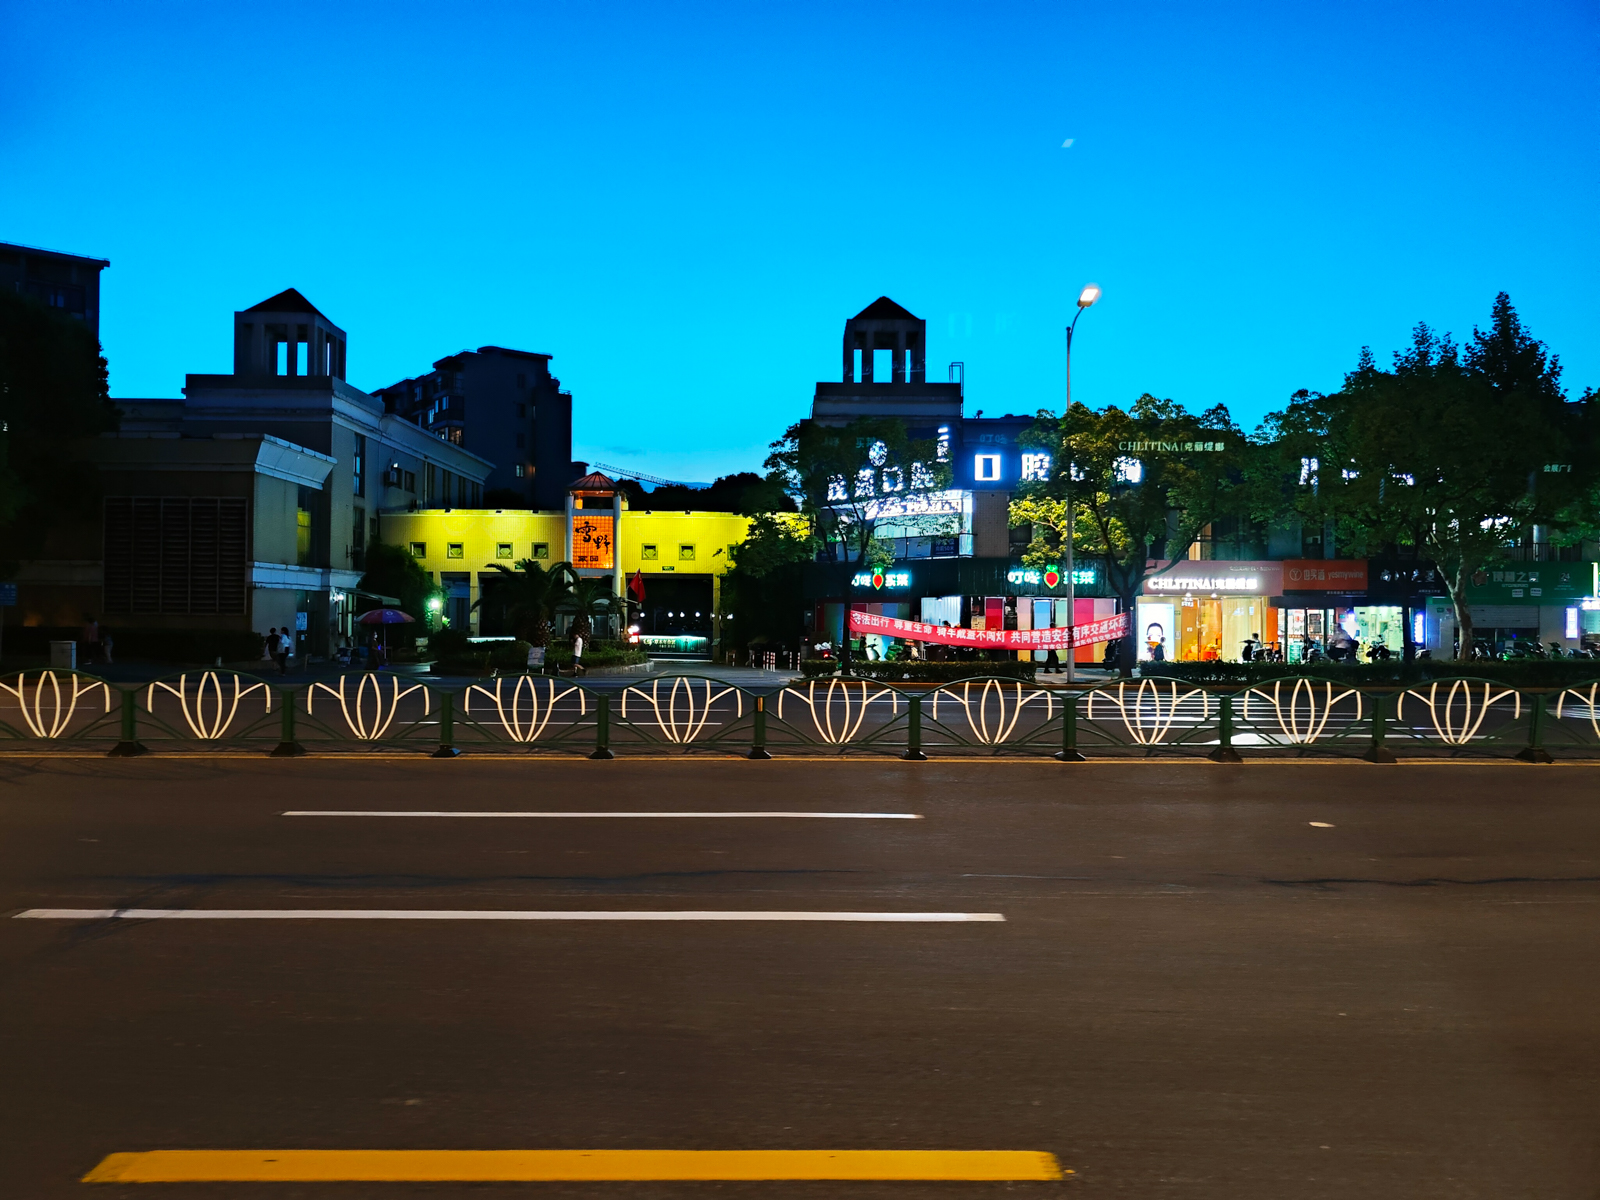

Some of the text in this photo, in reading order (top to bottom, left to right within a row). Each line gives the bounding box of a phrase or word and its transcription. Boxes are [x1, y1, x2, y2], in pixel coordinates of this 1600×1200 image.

[1118, 441, 1179, 452] CHLITINA
[1007, 571, 1041, 585] 叮咚
[851, 612, 890, 628] 守法出行
[893, 620, 933, 634] 尊重生命
